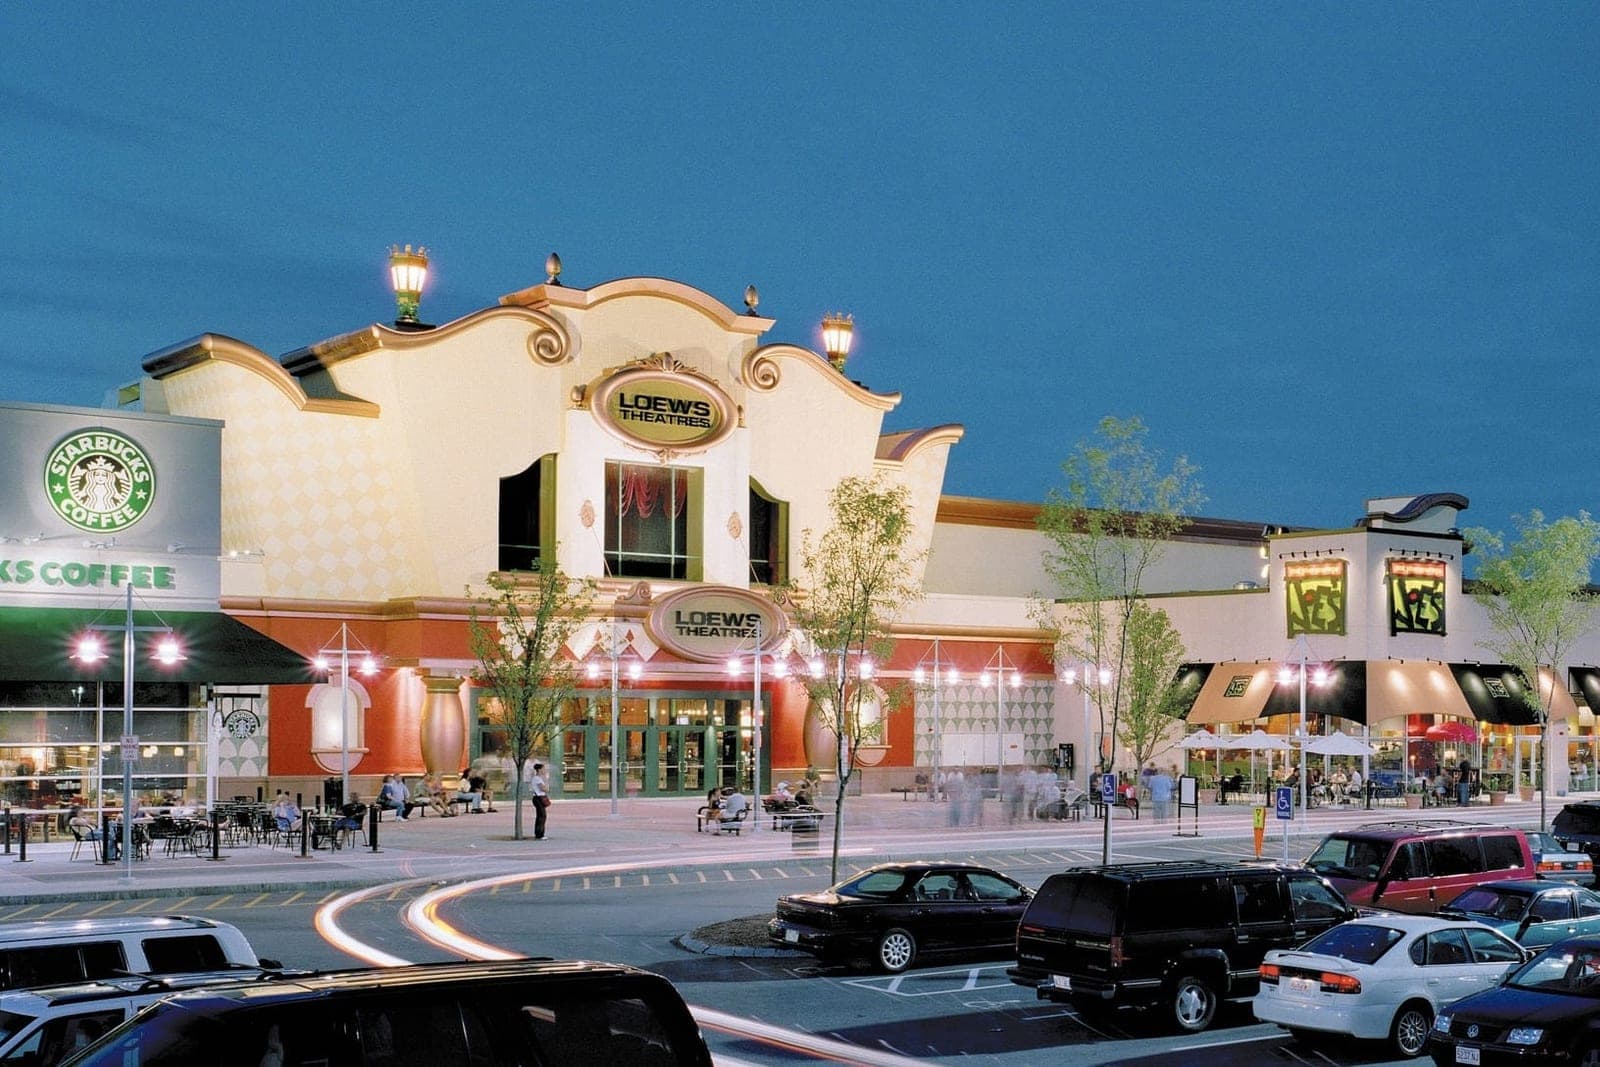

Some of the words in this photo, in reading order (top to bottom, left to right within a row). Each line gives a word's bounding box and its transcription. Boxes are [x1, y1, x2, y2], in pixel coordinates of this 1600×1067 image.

[619, 393, 711, 417] LOEWS
[619, 409, 711, 428] THEATRES
[51, 436, 149, 483] STARBUCKS
[60, 498, 138, 528] COFFEE
[40, 562, 175, 590] COFFEE
[675, 610, 762, 628] LOEWS
[675, 625, 762, 638] THEATRES
